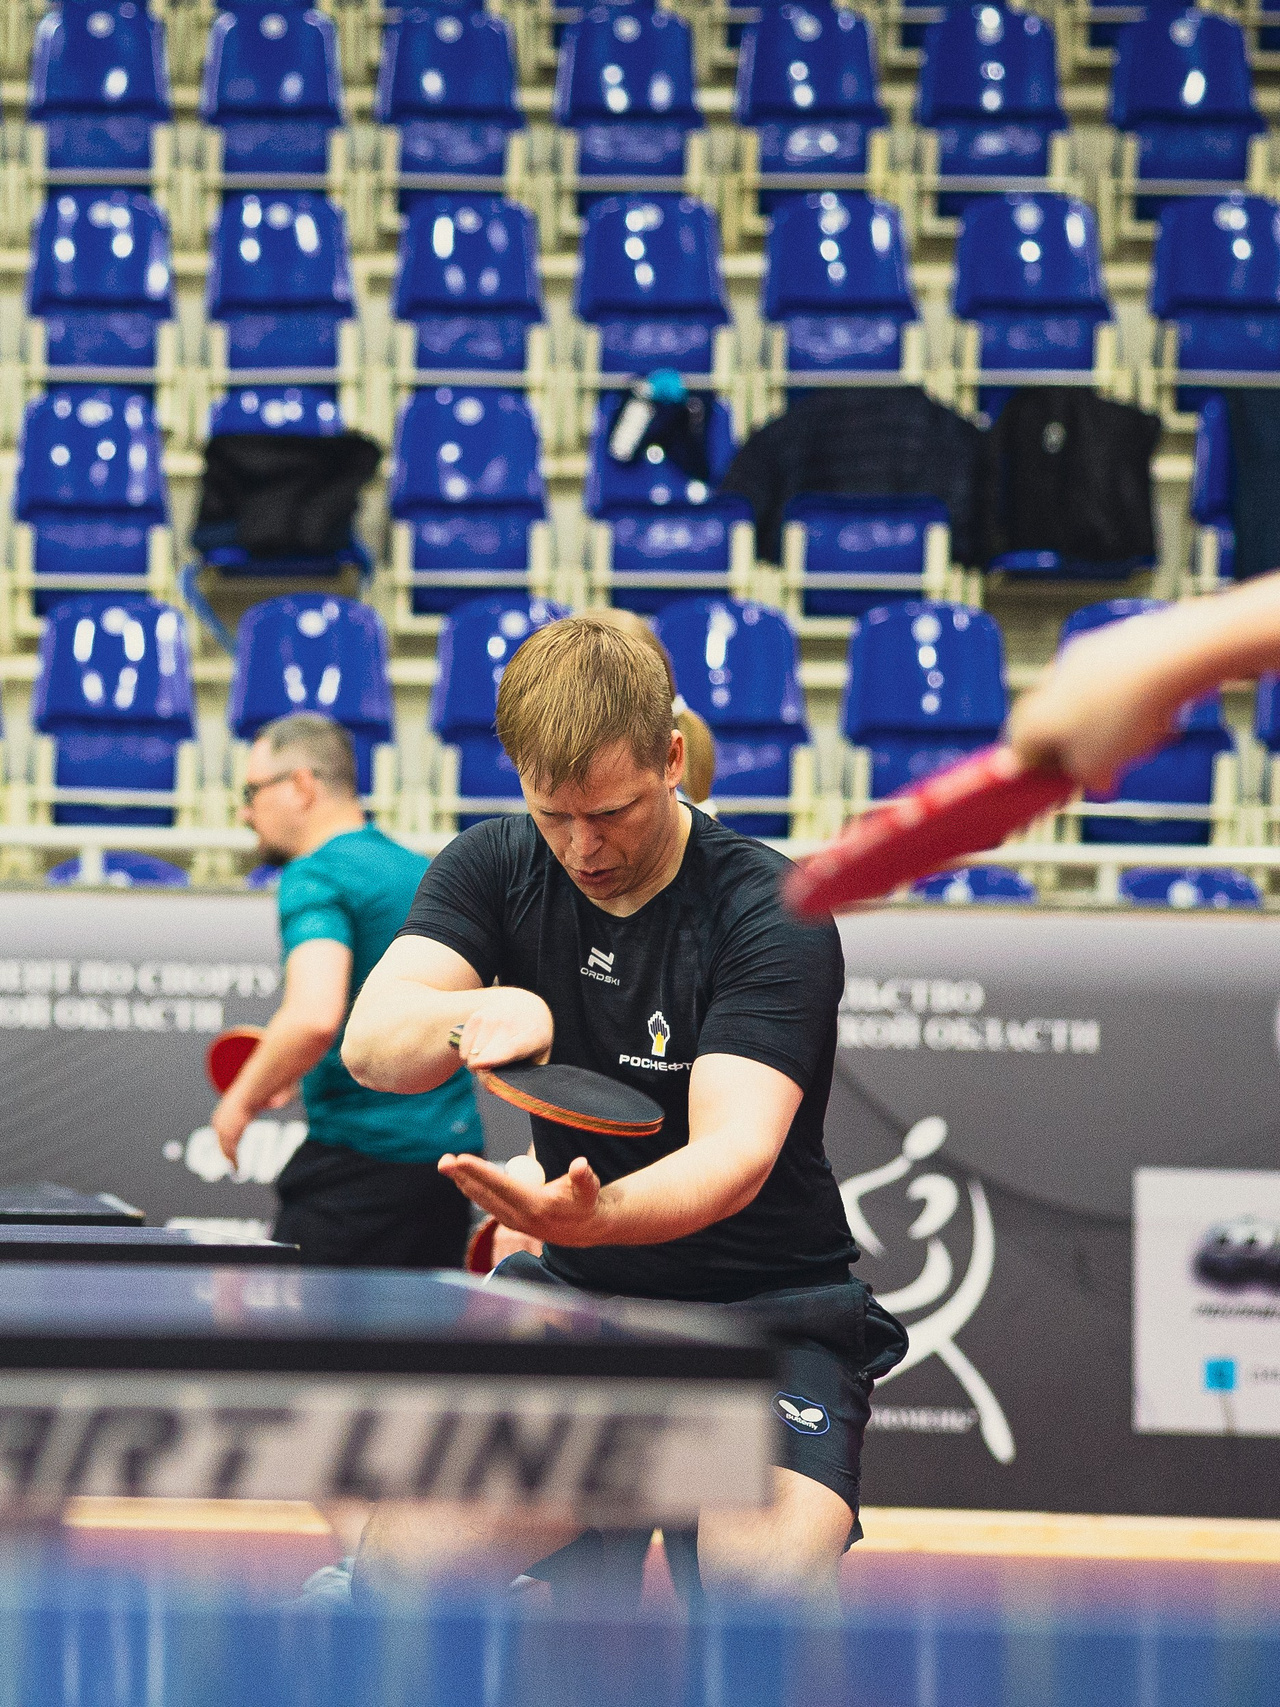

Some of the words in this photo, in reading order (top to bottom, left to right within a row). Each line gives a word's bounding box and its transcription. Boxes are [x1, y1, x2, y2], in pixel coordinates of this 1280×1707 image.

[78, 960, 135, 994] ПО
[53, 998, 223, 1032] ОБЛАСТИ
[618, 1053, 694, 1072] РОСНЕФТ
[328, 1403, 695, 1513] LINE
